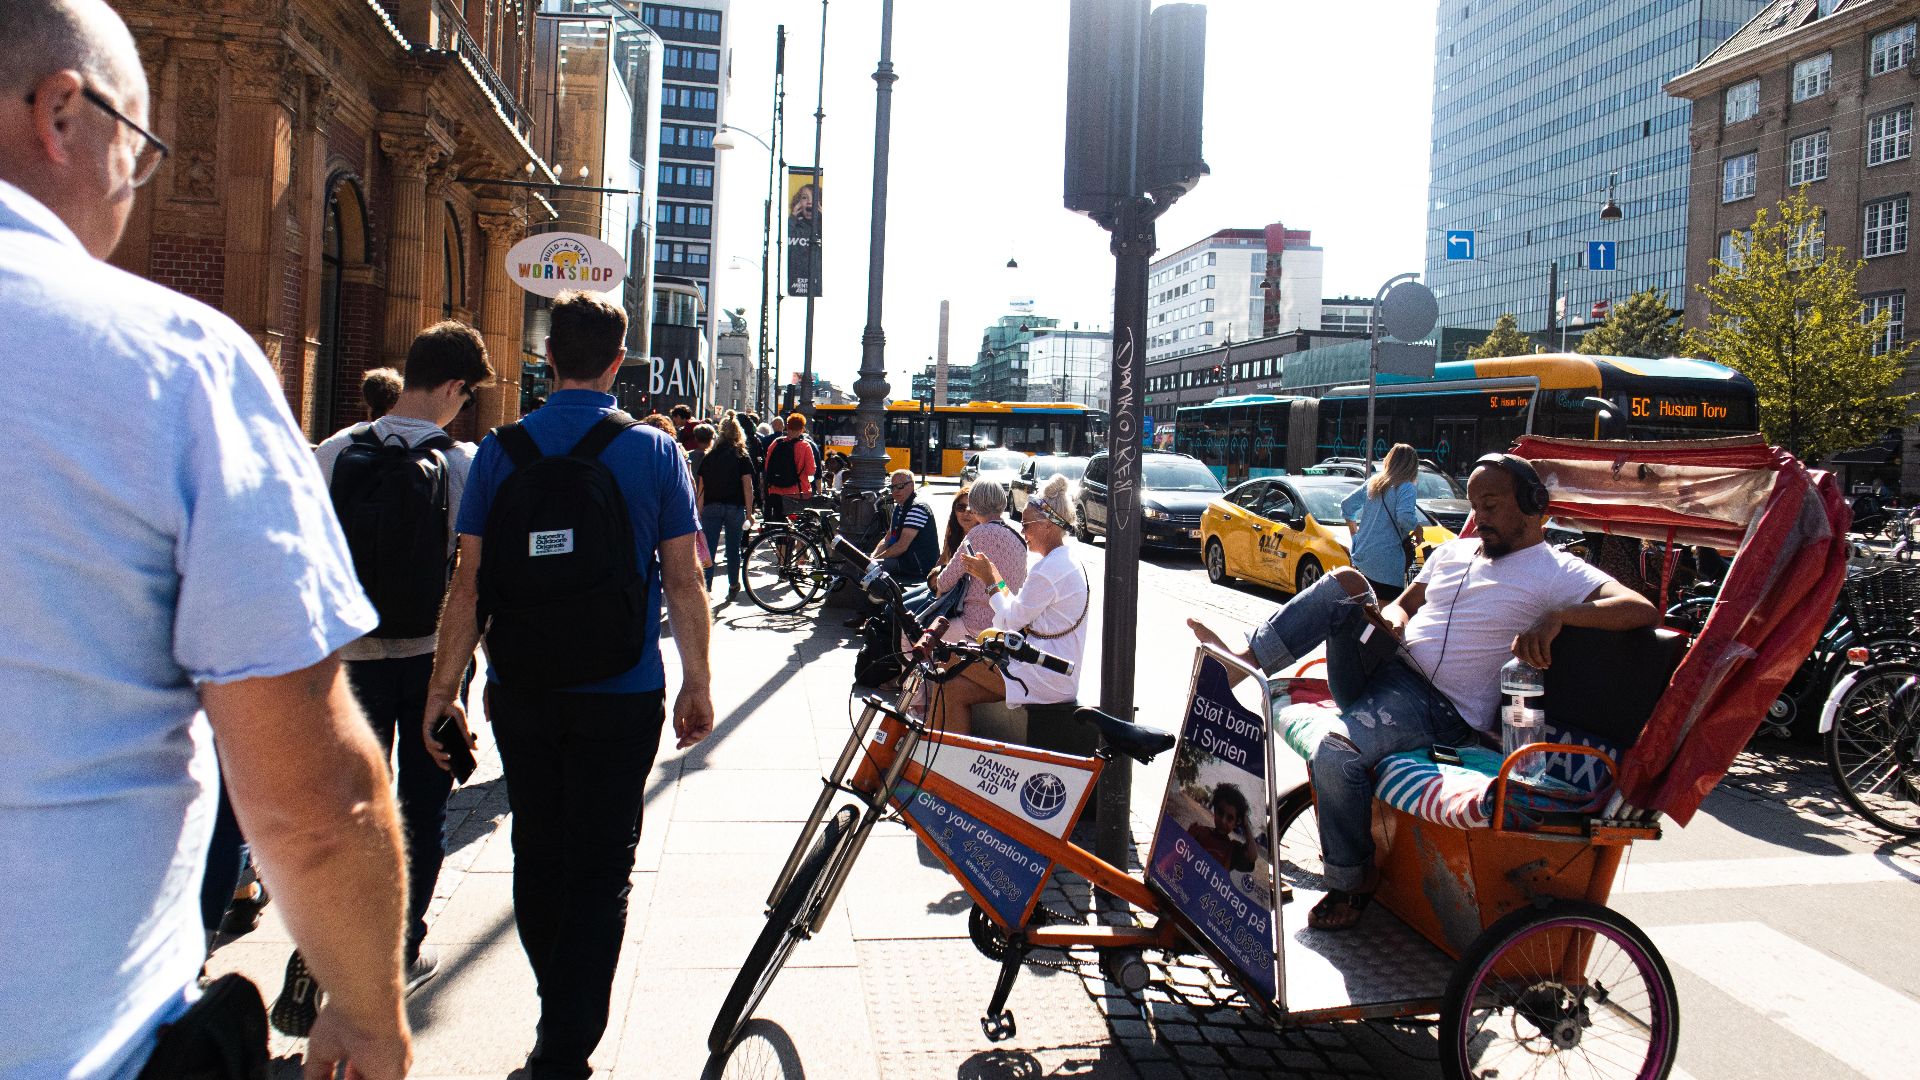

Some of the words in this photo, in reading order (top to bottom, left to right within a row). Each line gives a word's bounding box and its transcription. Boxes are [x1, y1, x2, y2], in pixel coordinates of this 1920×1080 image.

[518, 263, 613, 282] WORKSHOP
[1490, 396, 1499, 408] 5C
[1631, 397, 1651, 417] 5C
[1659, 400, 1697, 417] Husum
[1701, 402, 1727, 418] Torv
[1194, 697, 1223, 726] Støt
[1225, 710, 1260, 742] børn
[1192, 724, 1200, 742] i
[1201, 728, 1248, 766] Syrien
[969, 763, 1017, 793] MUSLIM
[976, 754, 1020, 782] DANISH
[976, 780, 999, 796] AID
[918, 792, 945, 816] Give
[945, 811, 977, 834] your
[976, 829, 1028, 867] donation
[1029, 860, 1046, 878] on
[963, 839, 995, 872] 4144
[1175, 838, 1195, 863] Giv
[1194, 859, 1211, 881] dit
[1210, 872, 1248, 918] bidrag
[1247, 912, 1267, 934] på
[1199, 893, 1234, 932] 4144
